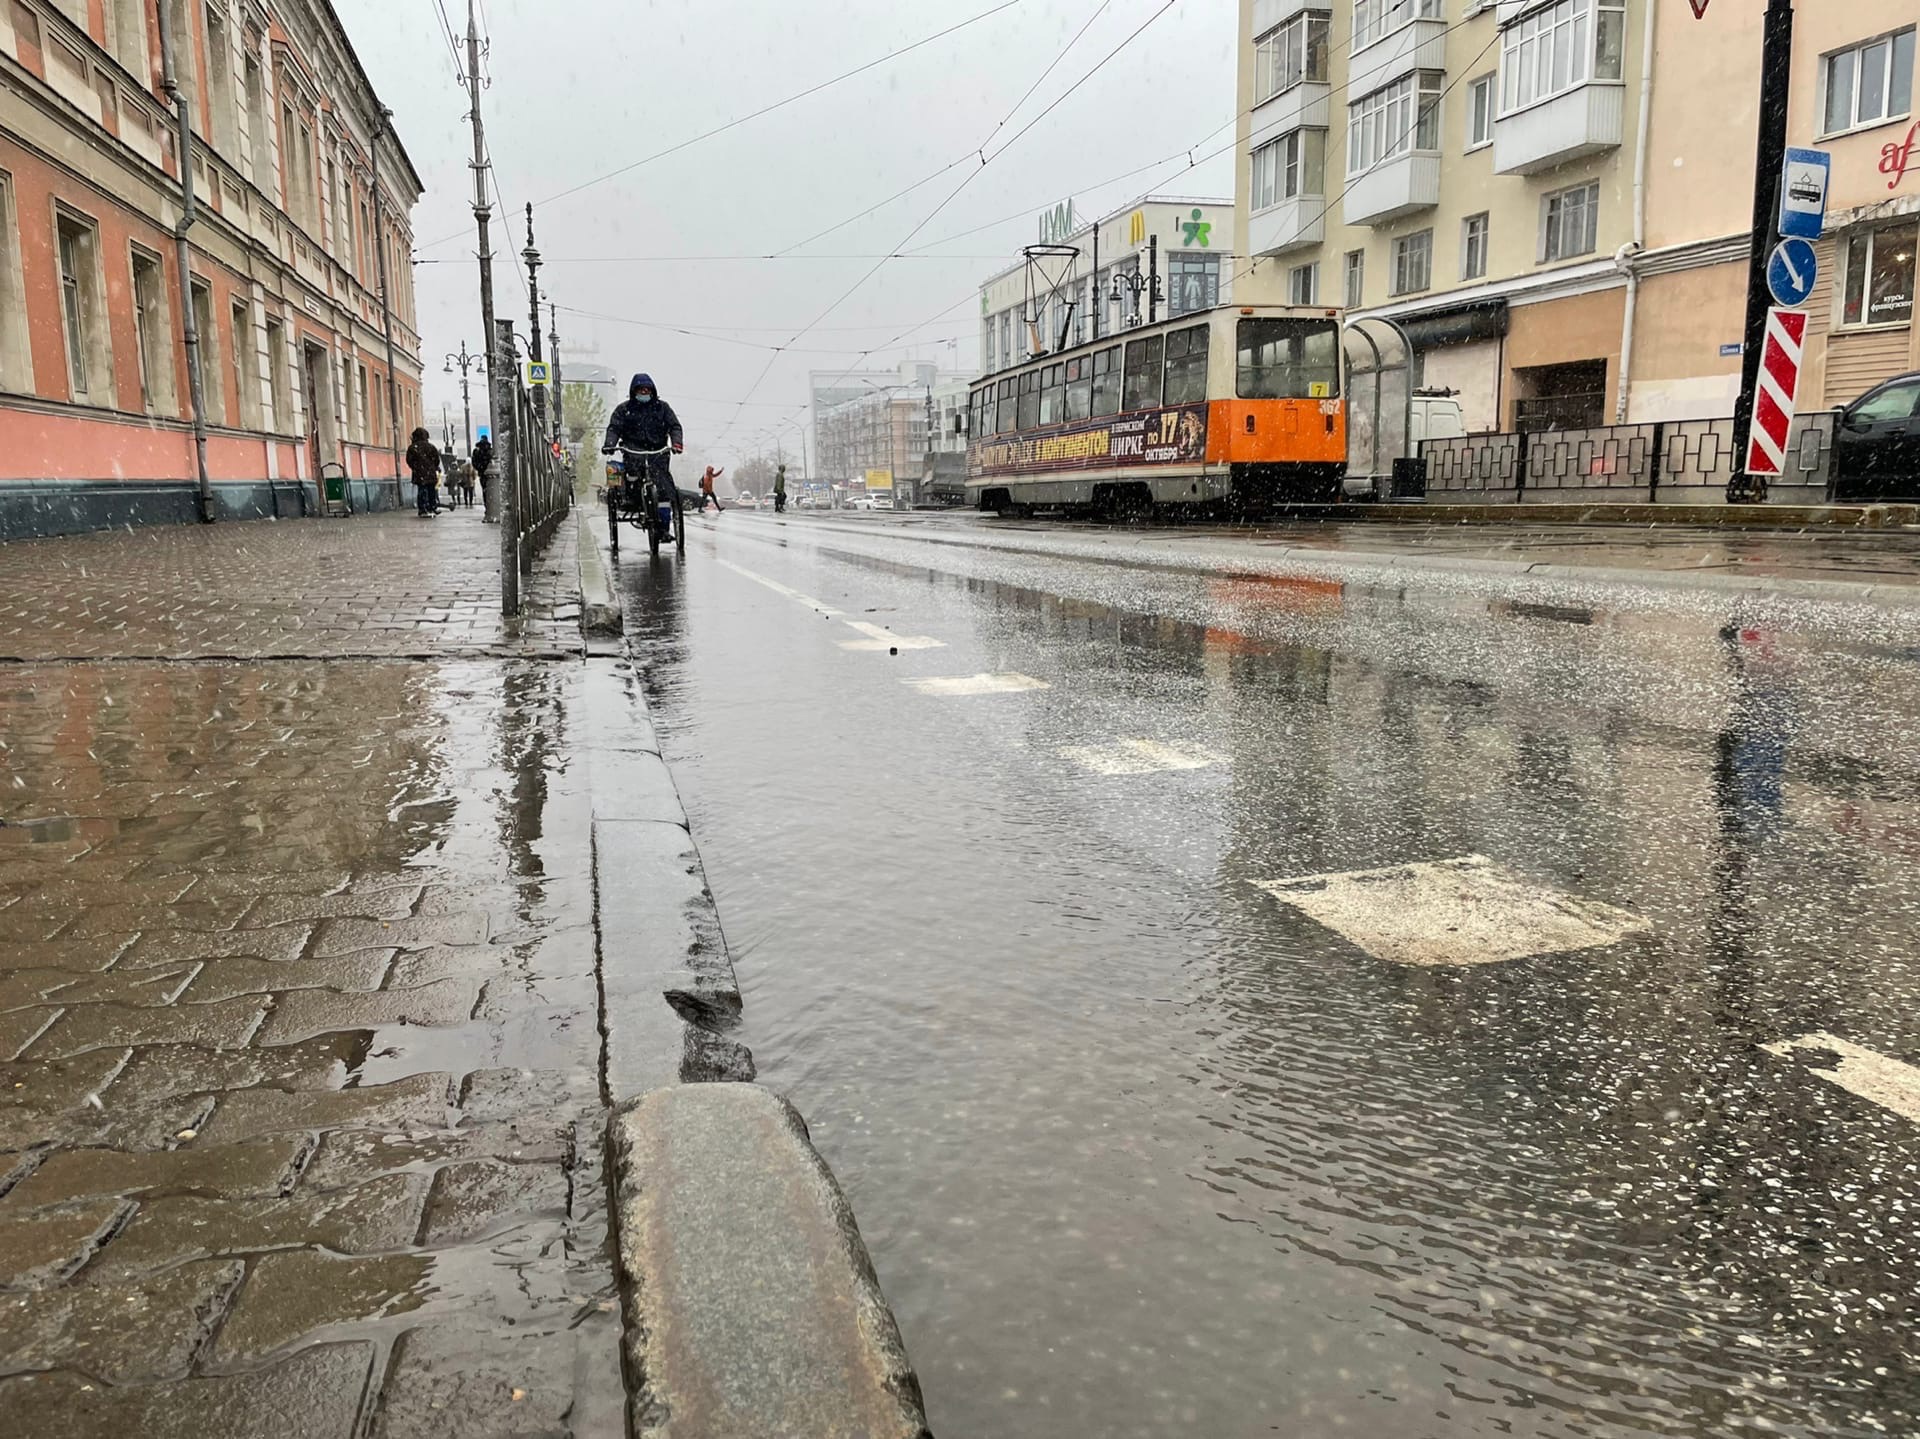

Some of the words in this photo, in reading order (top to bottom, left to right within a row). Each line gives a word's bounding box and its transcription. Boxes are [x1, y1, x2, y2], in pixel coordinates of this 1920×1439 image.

[1316, 385, 1323, 396] 7
[1160, 412, 1179, 444] 17
[1110, 435, 1143, 456] ЦИРКЕ
[1145, 447, 1178, 461] ОКТЯБРЯ
